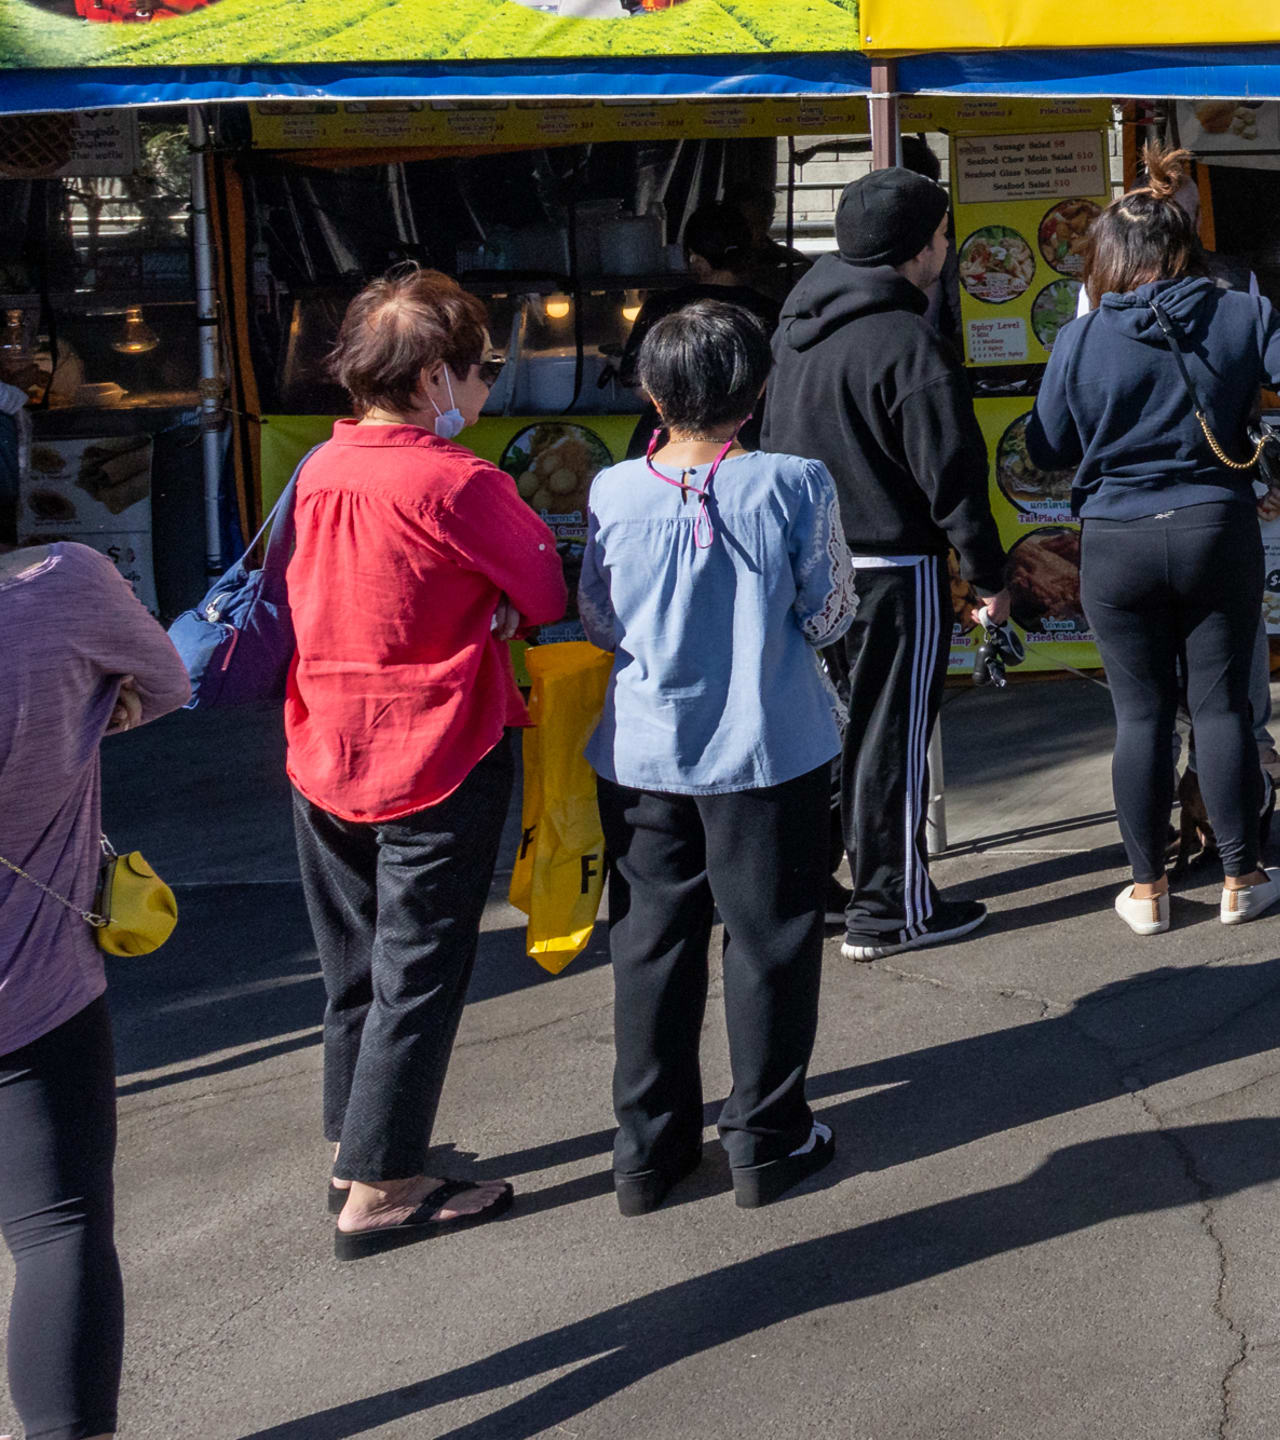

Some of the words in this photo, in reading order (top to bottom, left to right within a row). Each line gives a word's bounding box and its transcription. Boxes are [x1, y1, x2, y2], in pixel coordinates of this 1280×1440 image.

[967, 158, 999, 166] Seafood
[1051, 153, 1073, 161] Salad
[993, 182, 1025, 191] Seafood
[1028, 180, 1050, 188] Salad
[971, 323, 994, 332] Spicy
[997, 321, 1020, 330] Level
[1026, 633, 1055, 642] Fried
[1055, 632, 1095, 642] Chicken
[581, 854, 598, 894] F
